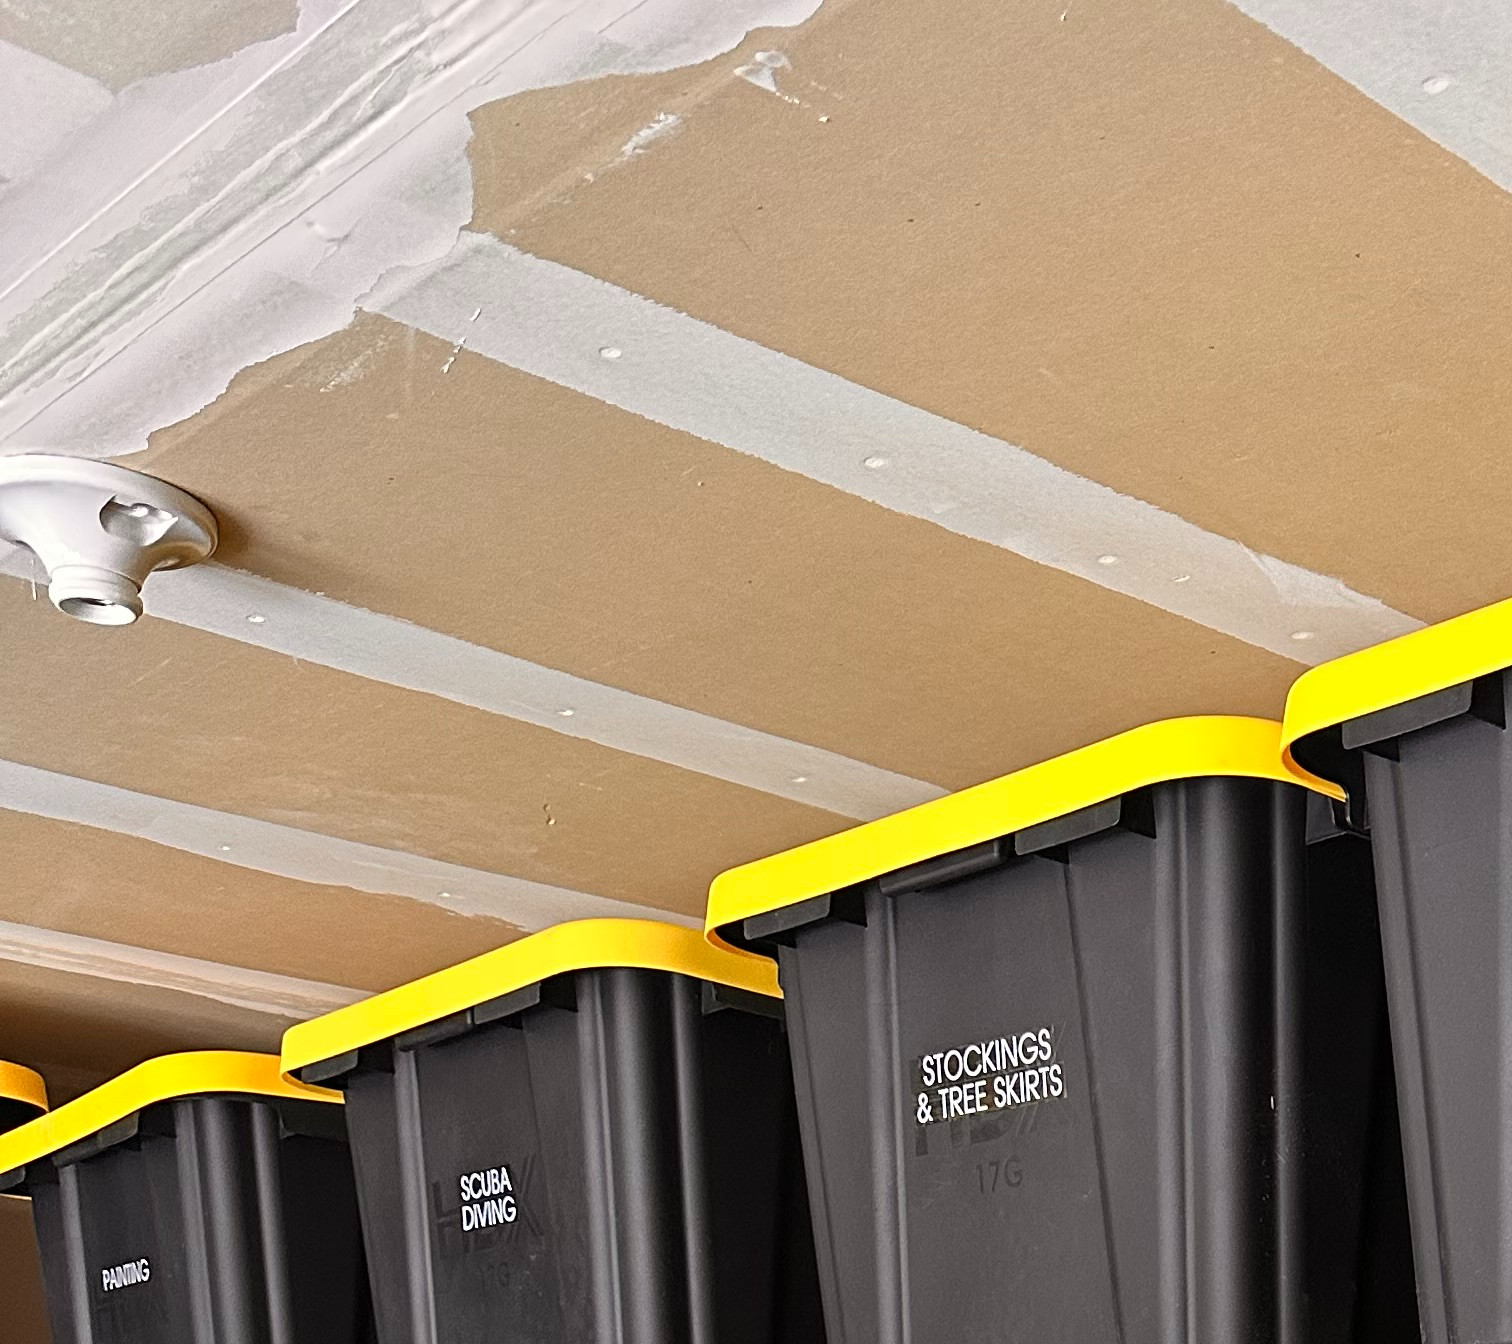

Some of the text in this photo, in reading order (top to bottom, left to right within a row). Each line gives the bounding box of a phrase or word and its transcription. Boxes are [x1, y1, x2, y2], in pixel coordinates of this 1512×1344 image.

[922, 1027, 1052, 1087] STOCKINGS
[916, 1063, 1063, 1124] & TREE SKIRTS
[459, 1166, 513, 1202] SCUBA
[975, 1155, 1024, 1194] 17G
[460, 1195, 517, 1232] DIVING
[101, 1258, 150, 1292] PAINTING
